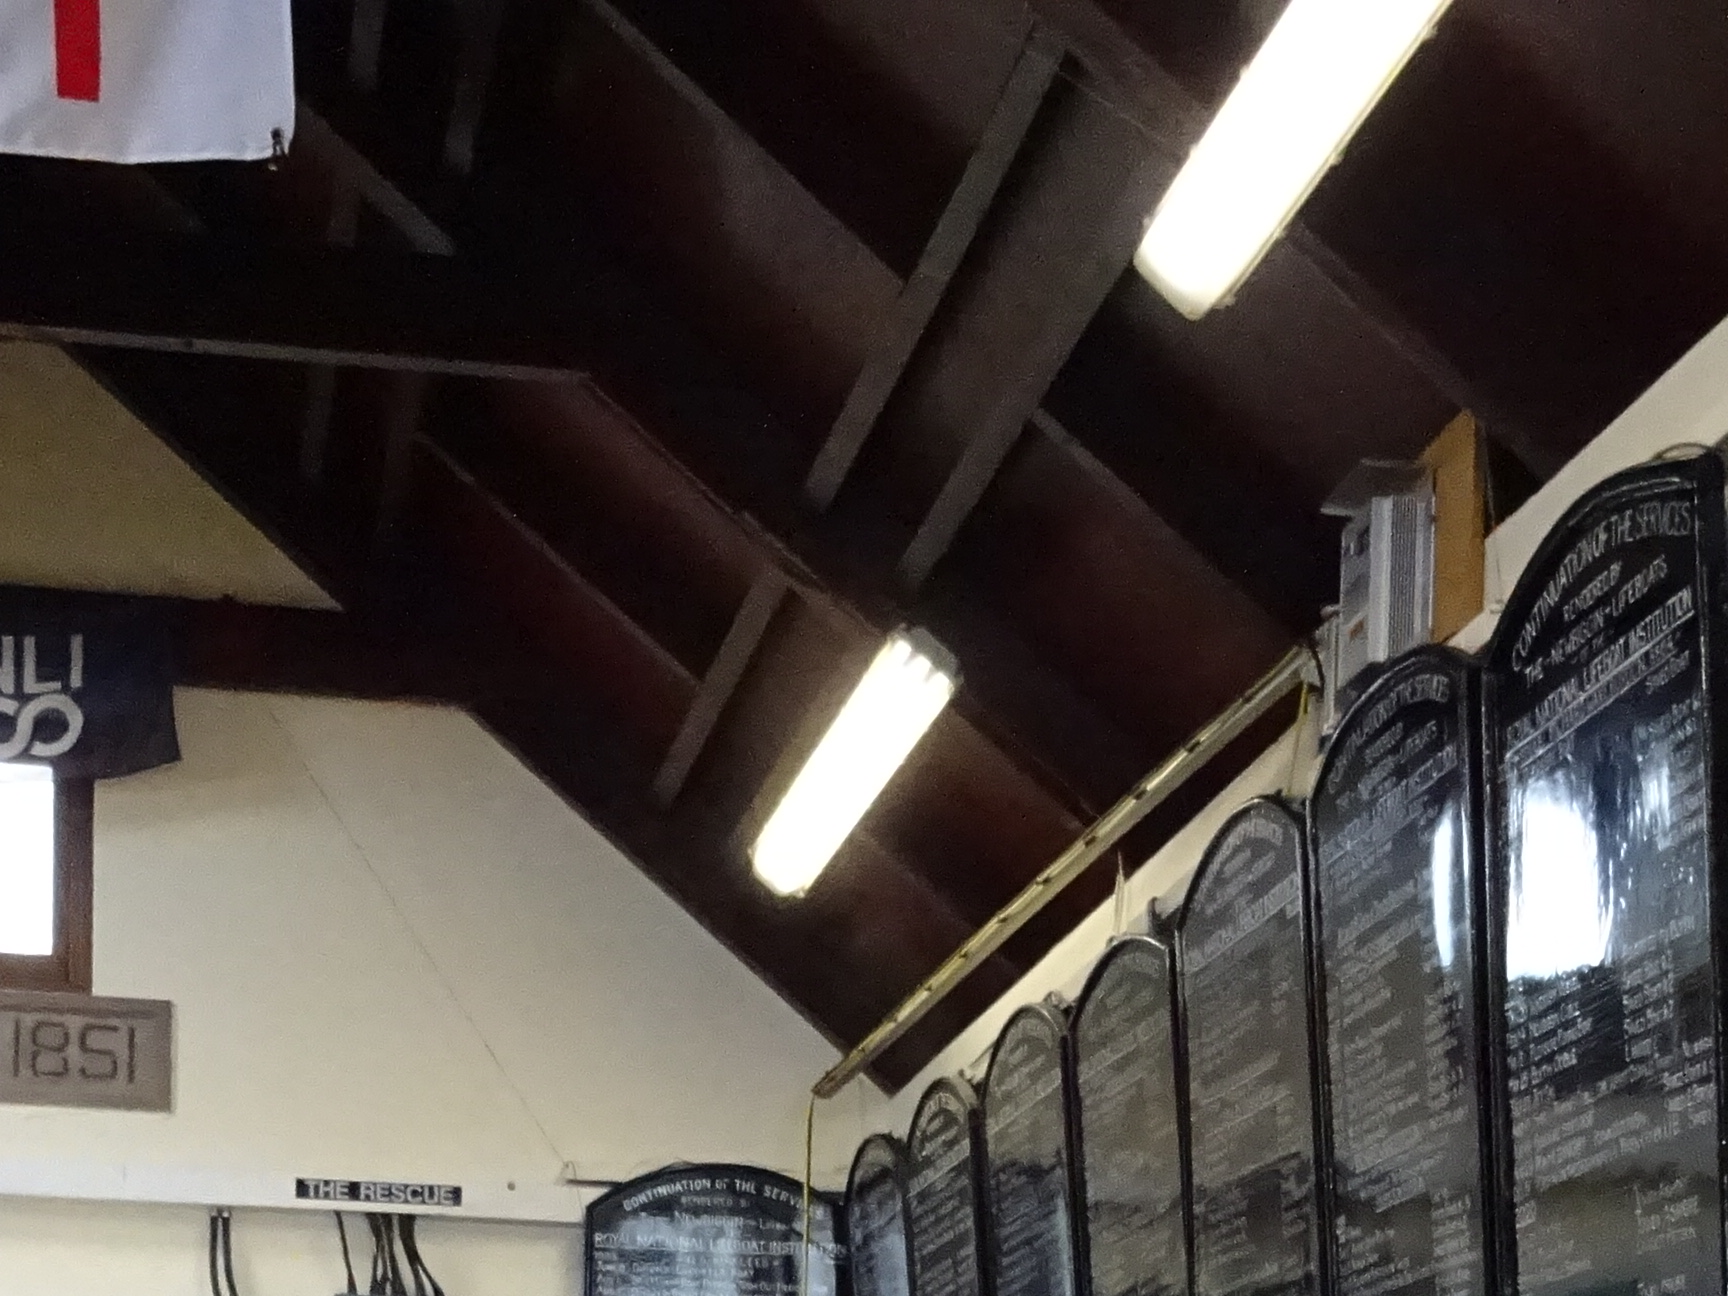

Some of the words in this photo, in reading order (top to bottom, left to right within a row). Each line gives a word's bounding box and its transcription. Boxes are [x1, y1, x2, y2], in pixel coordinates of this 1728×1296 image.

[11, 1016, 137, 1084] 1851
[304, 1179, 350, 1200] THE
[360, 1182, 455, 1206] RESCUE
[622, 1177, 712, 1212] CONTINUATION
